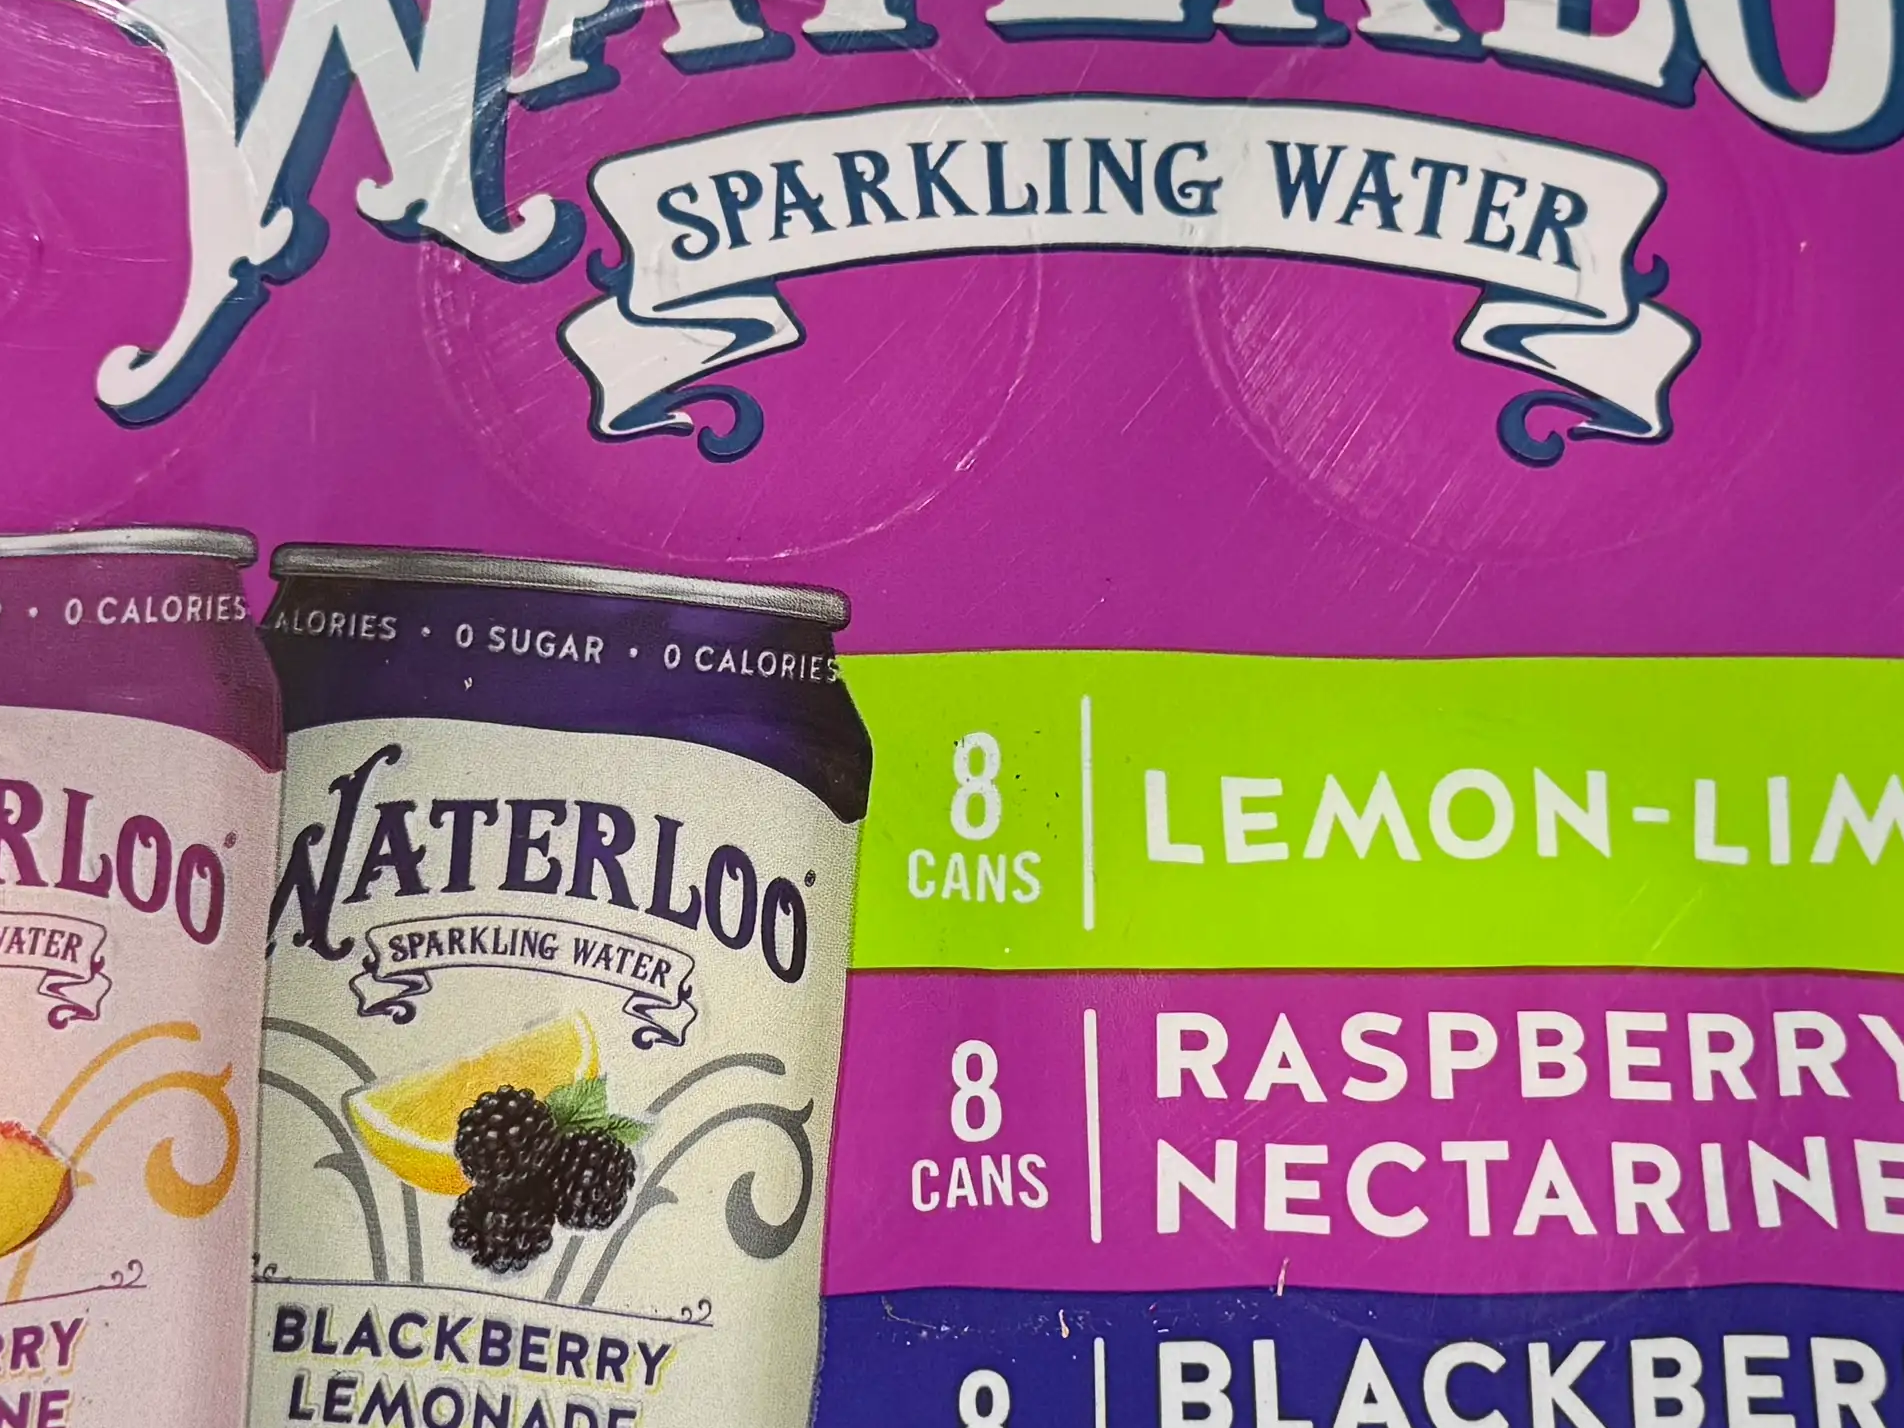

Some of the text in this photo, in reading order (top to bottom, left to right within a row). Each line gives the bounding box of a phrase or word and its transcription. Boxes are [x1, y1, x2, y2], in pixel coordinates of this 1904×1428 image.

[656, 138, 1590, 269] SPARKLING WATER
[97, 595, 248, 626] CALORIES
[272, 608, 398, 642] ALORIES
[488, 624, 605, 666] SUGAR
[694, 644, 842, 684] CALORIES
[951, 732, 1002, 841] 8
[907, 848, 1042, 904] CANS
[388, 927, 673, 988] SPARKLING WATER
[950, 1039, 1003, 1144] 8
[910, 1152, 1050, 1213] CANS
[271, 1304, 673, 1388] BLACKBERRY
